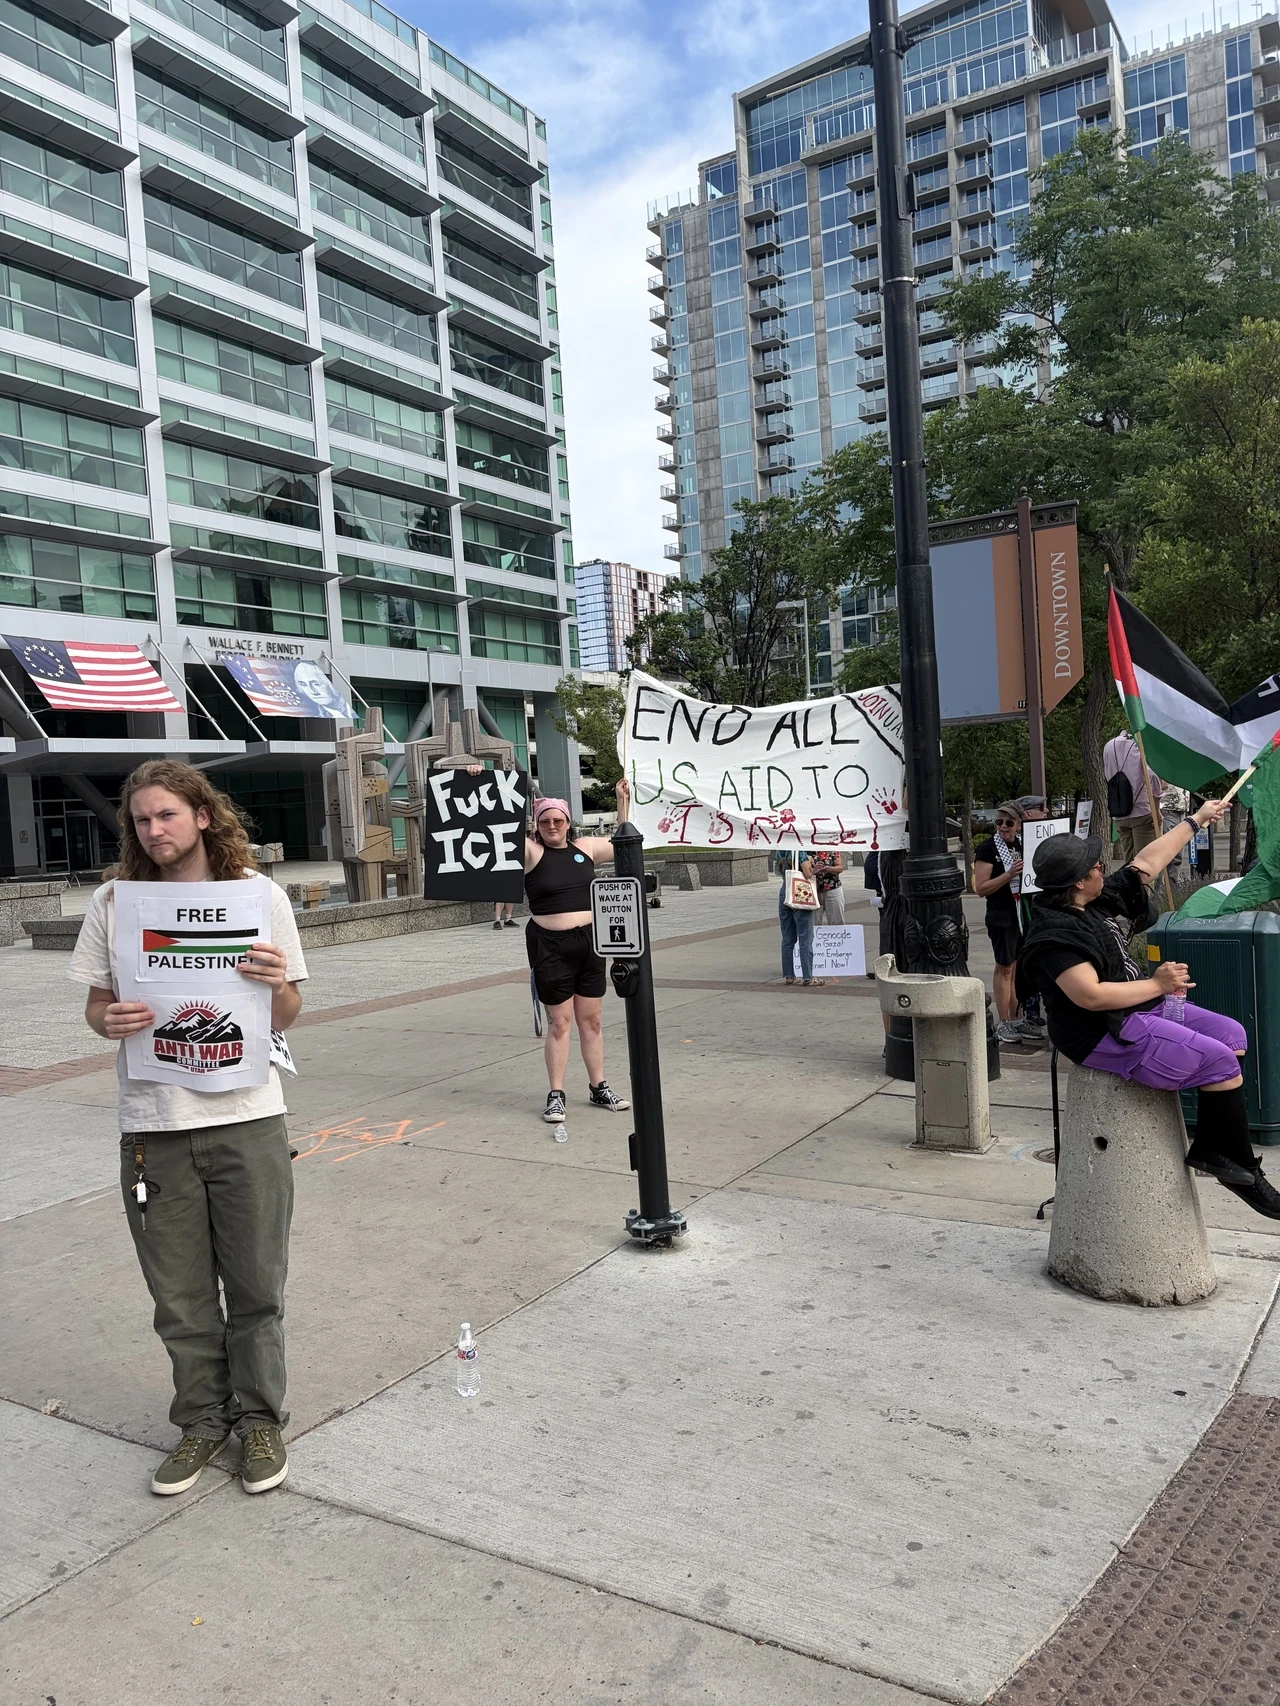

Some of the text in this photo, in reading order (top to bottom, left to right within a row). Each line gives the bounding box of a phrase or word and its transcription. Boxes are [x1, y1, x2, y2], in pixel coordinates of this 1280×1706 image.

[1051, 552, 1072, 679] DOWNTOWN
[209, 636, 253, 651] WALLACE
[257, 641, 264, 652] F.
[266, 642, 305, 655] BENNETT
[857, 692, 892, 721] JOIN
[632, 685, 860, 751] END ALL
[719, 765, 794, 812] AID
[801, 764, 870, 798] TO
[1036, 824, 1056, 839] END
[431, 821, 524, 874] ICE
[598, 883, 632, 891] PUSH OR
[598, 894, 633, 902] WAVE AT
[176, 907, 227, 923] FREE
[601, 905, 632, 913] BUTTON
[609, 916, 625, 924] FOR
[816, 927, 852, 940] Genocide
[826, 948, 853, 961] Embargo
[812, 959, 827, 970] srael
[831, 959, 849, 969] Now!
[153, 1039, 244, 1061] ANTI WAR
[176, 1056, 220, 1068] COMMITTEE
[190, 1066, 206, 1074] UTAH
